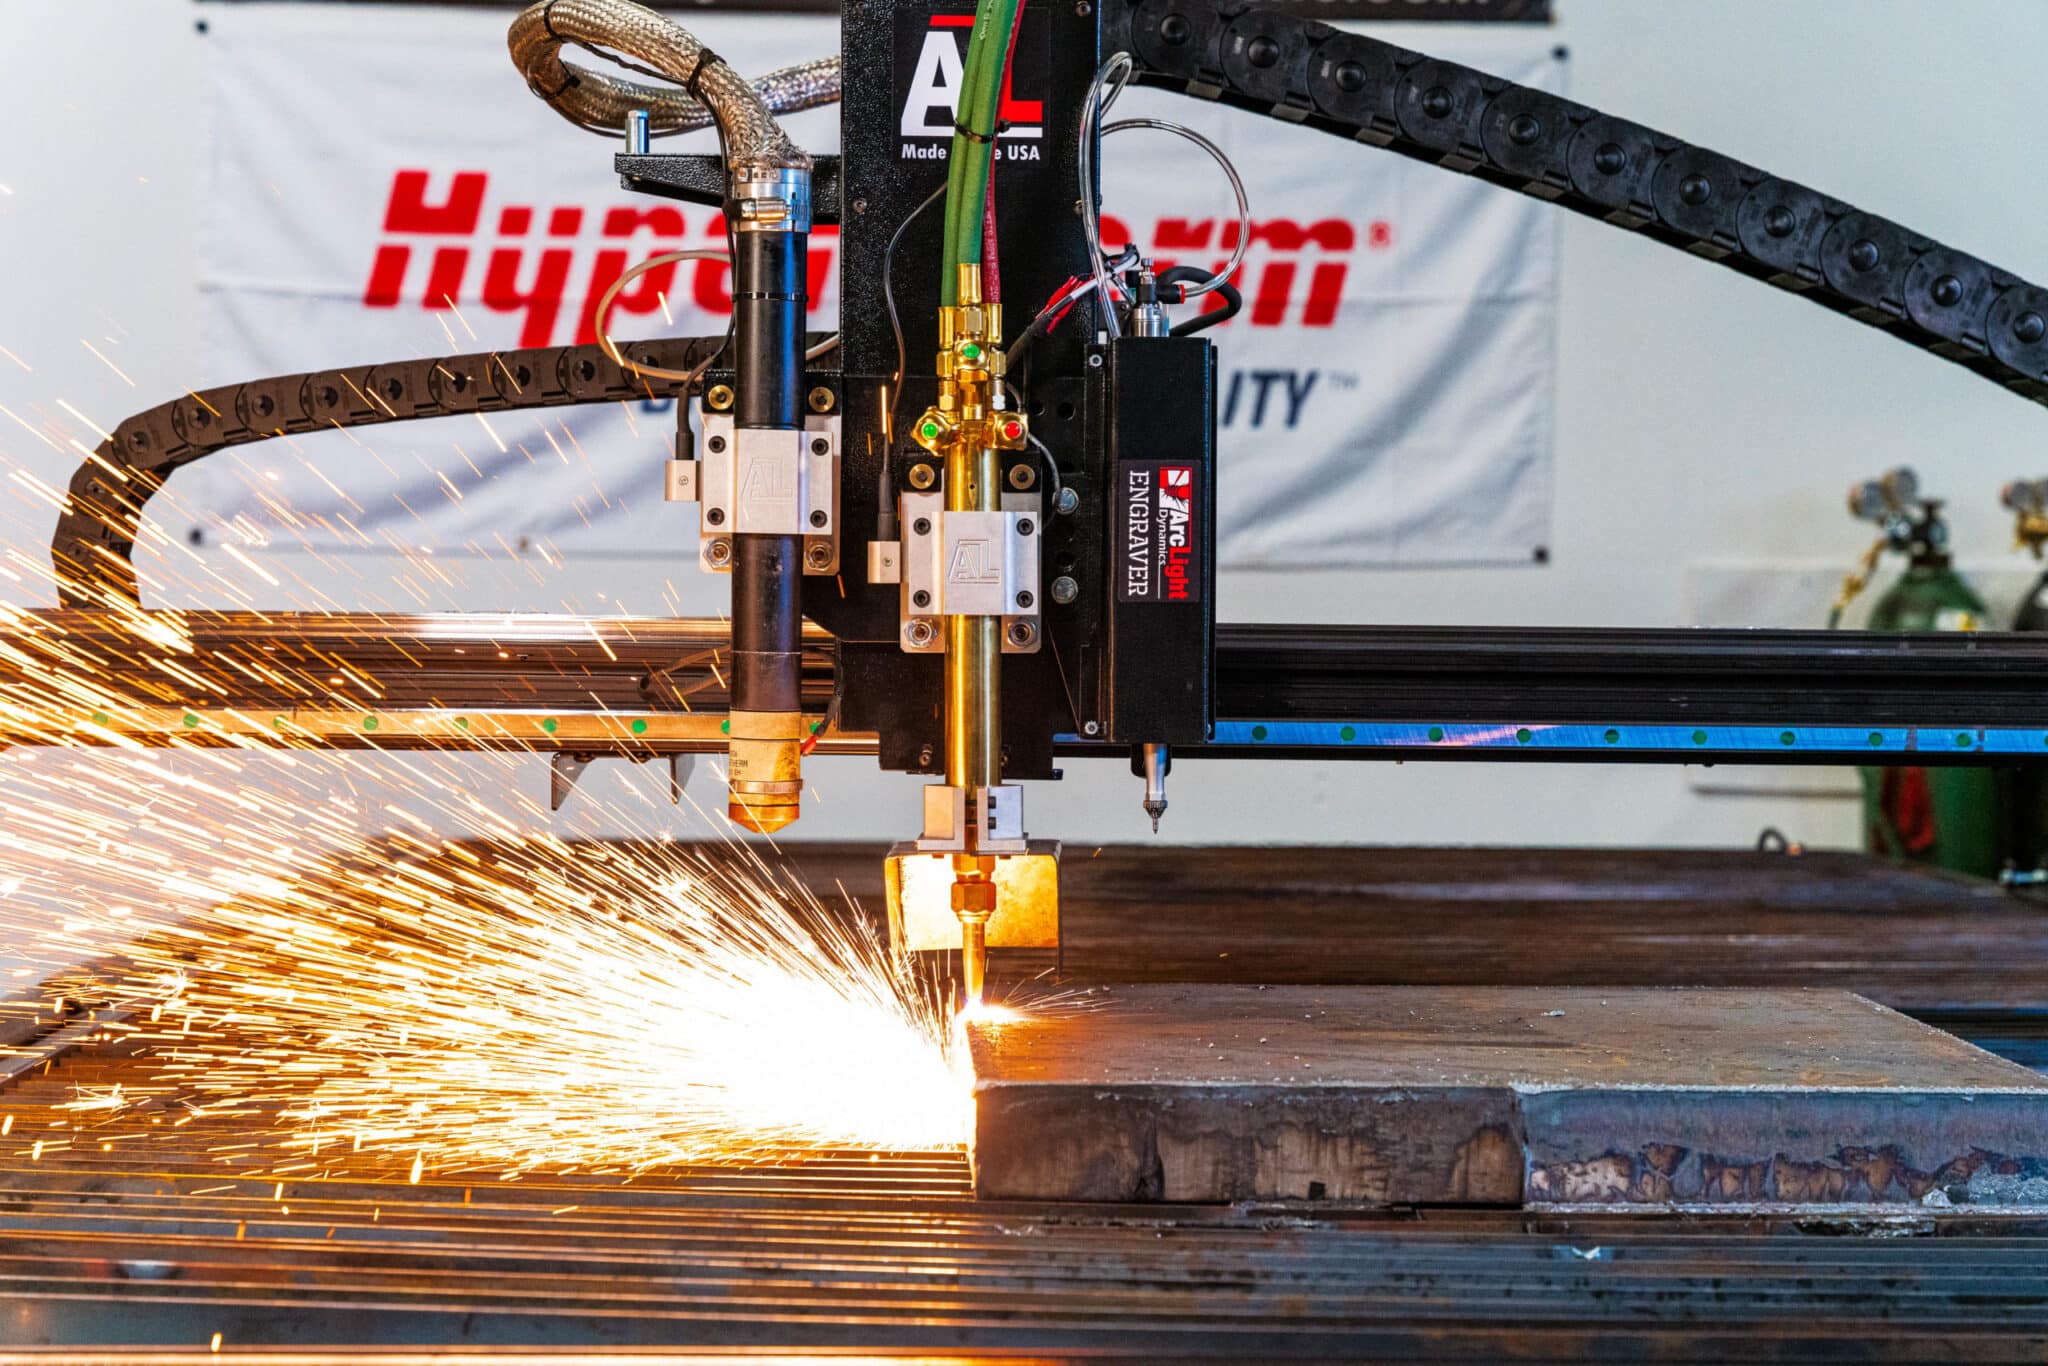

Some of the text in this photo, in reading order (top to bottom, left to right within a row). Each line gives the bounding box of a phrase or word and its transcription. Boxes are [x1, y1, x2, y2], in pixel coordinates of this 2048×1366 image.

[901, 143, 947, 160] Made
[1007, 145, 1041, 161] USA
[1127, 469, 1150, 597] ENGRAVER
[1156, 508, 1168, 565] Dynamics
[1164, 508, 1192, 600] ArcLight
